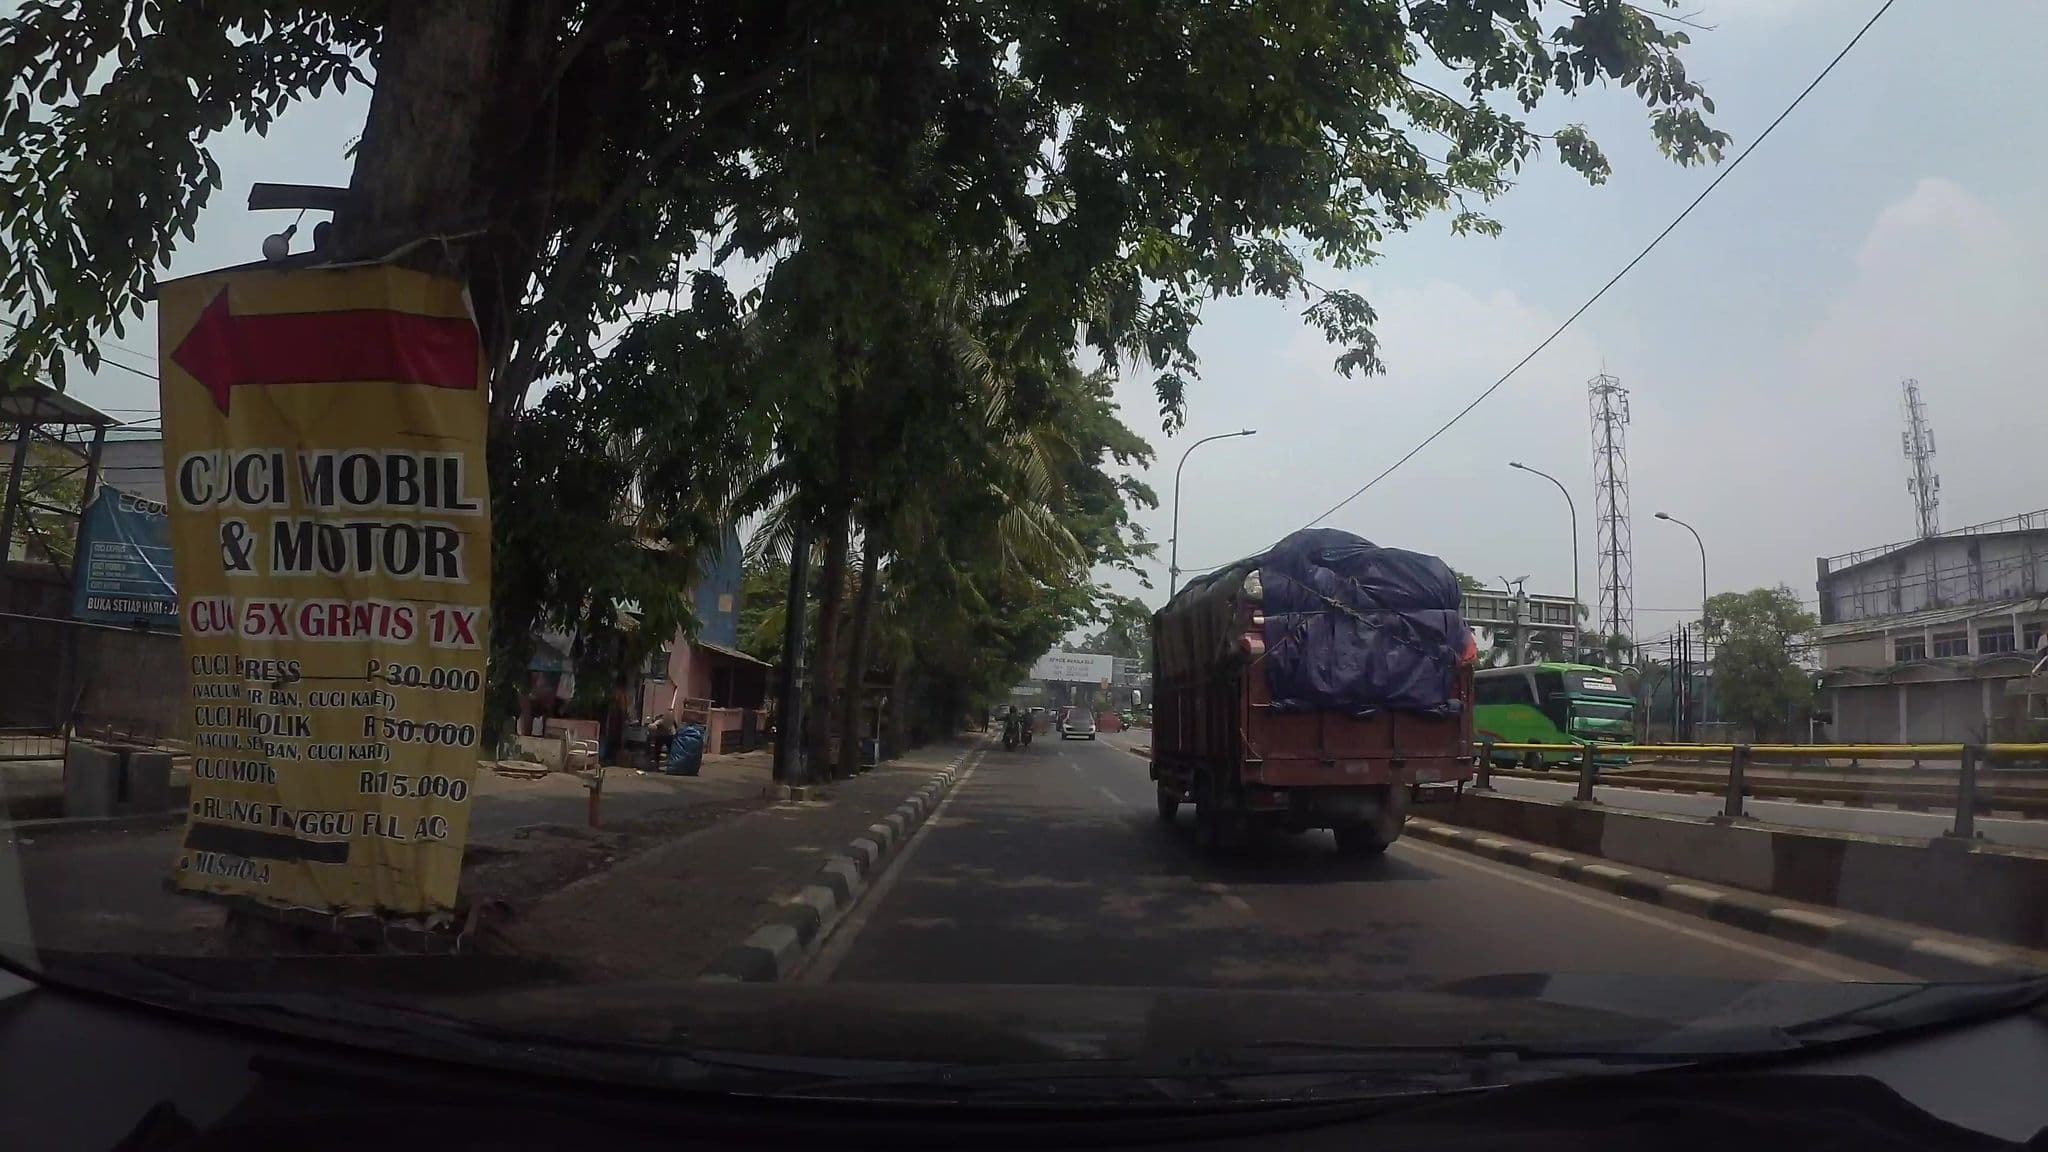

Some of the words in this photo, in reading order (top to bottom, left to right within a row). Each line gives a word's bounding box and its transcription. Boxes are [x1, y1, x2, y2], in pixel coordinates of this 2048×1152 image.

[180, 453, 284, 506] CUCI
[298, 453, 478, 510] MOBIL
[221, 520, 253, 571] &
[273, 520, 460, 579] MOTOR
[87, 597, 111, 611] BUKA
[112, 599, 141, 613] SETIAP
[243, 603, 288, 636] 5X
[299, 603, 414, 639] GRATIS
[429, 609, 475, 645] 1X
[191, 655, 229, 676] CUCI
[309, 691, 345, 707] CUCI
[195, 706, 231, 727] CUCI
[308, 744, 343, 760] CUCI
[414, 815, 447, 839] AC
